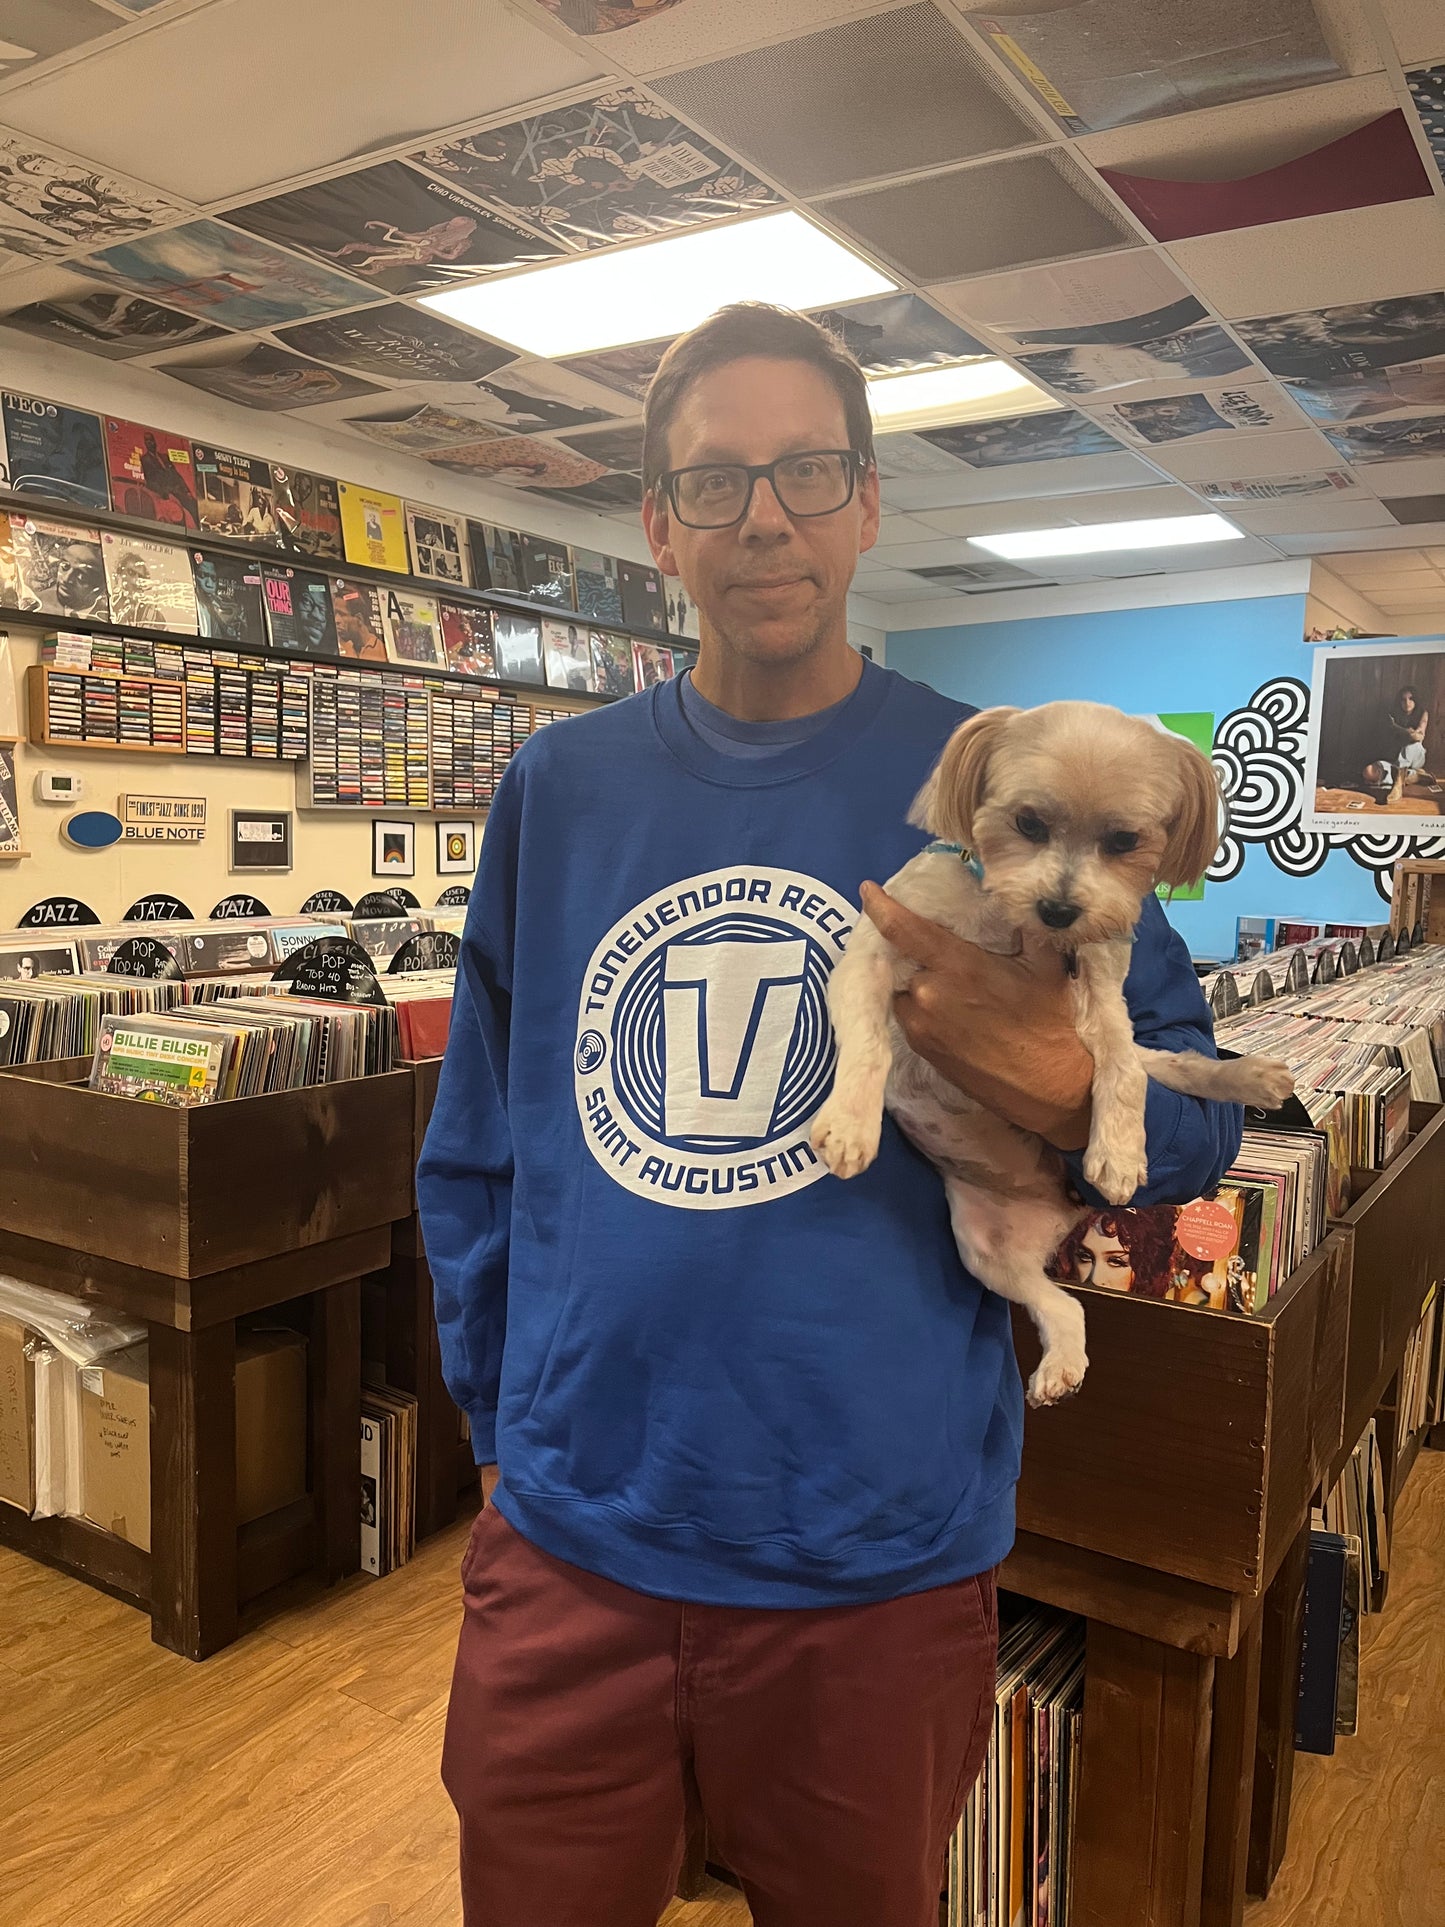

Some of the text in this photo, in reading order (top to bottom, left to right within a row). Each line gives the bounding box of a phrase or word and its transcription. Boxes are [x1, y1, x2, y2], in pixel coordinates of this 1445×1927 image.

[427, 183, 449, 196] CHAD
[344, 329, 447, 376] WINDOWS
[382, 340, 440, 363] ROSE
[4, 393, 46, 417] TEO
[214, 451, 250, 468] SONNY TERRY
[548, 559, 565, 575] ELSE
[266, 579, 290, 601] OUR
[269, 598, 293, 616] THING
[136, 801, 155, 816] FINEST
[159, 803, 172, 817] JAZZ
[174, 803, 189, 818] SINCE
[191, 803, 203, 818] 1939
[126, 826, 206, 840] BLUE NOTE
[445, 896, 466, 905] JAZZ
[446, 888, 465, 896] USED
[31, 904, 79, 923] JAZZ
[133, 902, 180, 921] JAZZ
[216, 899, 254, 918] JAZZ
[305, 899, 341, 912] JAZZ
[132, 940, 155, 958] POP
[280, 936, 317, 946] SONNY
[415, 934, 454, 956] ROCK
[586, 878, 772, 1014] TONEVENDOR
[113, 957, 130, 975] TOP
[133, 962, 145, 977] 40
[321, 954, 346, 969] POP
[404, 956, 428, 971] POP
[305, 968, 341, 982] TOP 40
[295, 980, 338, 993] RADIO HITS
[114, 1033, 158, 1050] BILLIE
[161, 1039, 208, 1057] EILISH
[126, 1048, 145, 1056] MUSIC
[177, 1055, 206, 1064] CONCERT
[192, 1070, 203, 1082] 4
[585, 1087, 642, 1167] SAINT
[1182, 1215, 1233, 1230] CHAPPELL ROAN
